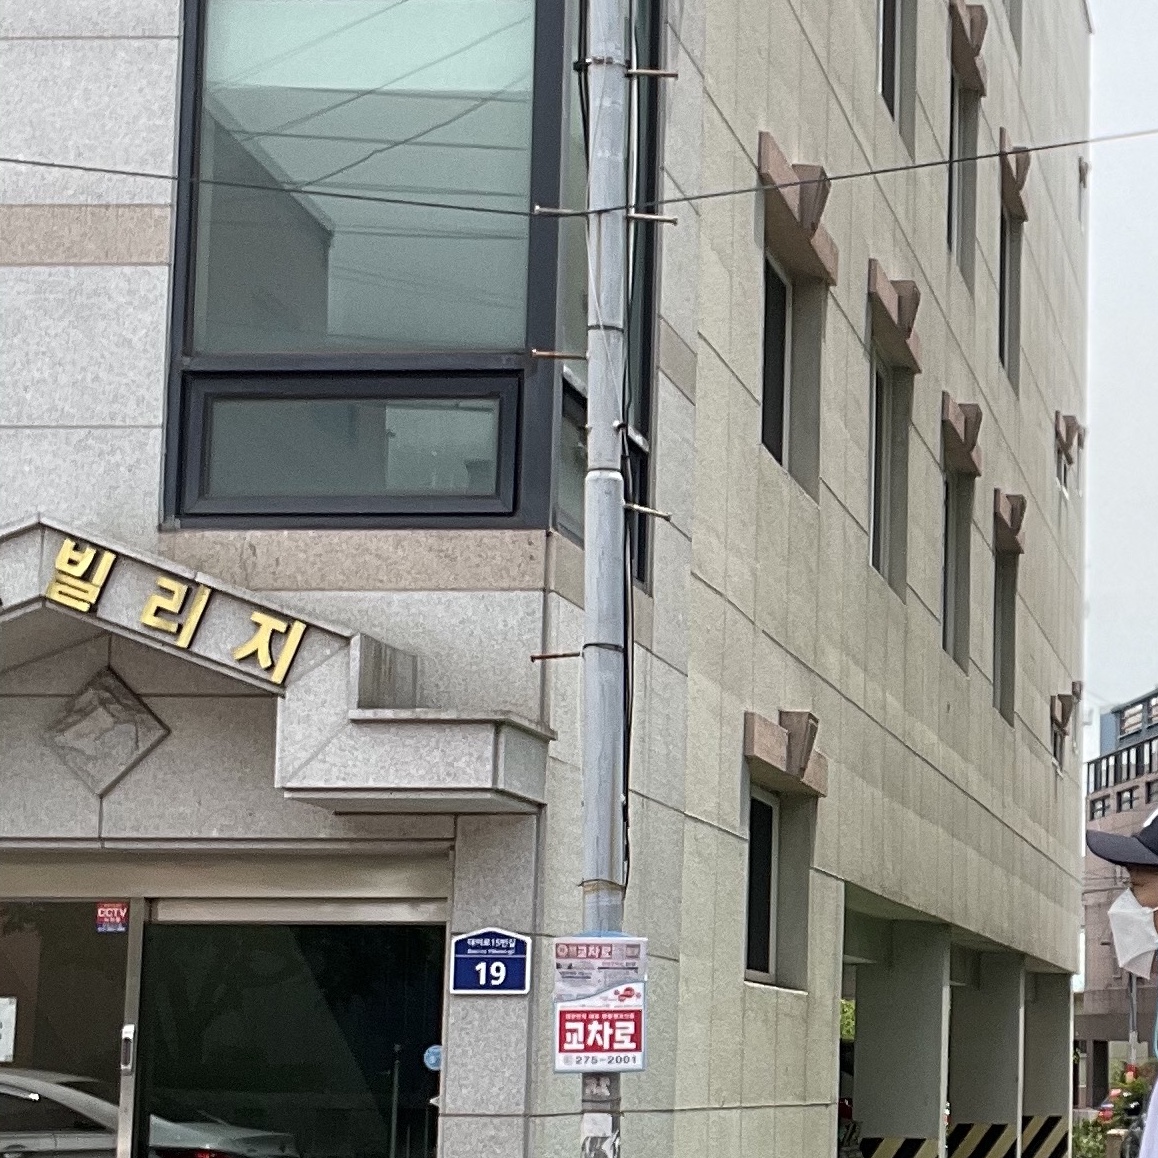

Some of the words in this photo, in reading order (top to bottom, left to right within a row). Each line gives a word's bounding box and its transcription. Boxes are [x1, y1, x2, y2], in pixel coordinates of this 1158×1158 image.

[46, 538, 307, 685] 빌리지
[97, 907, 128, 918] CCTV
[475, 961, 506, 985] 19
[563, 1020, 637, 1050] 교차로
[575, 1055, 637, 1064] 275-2001
